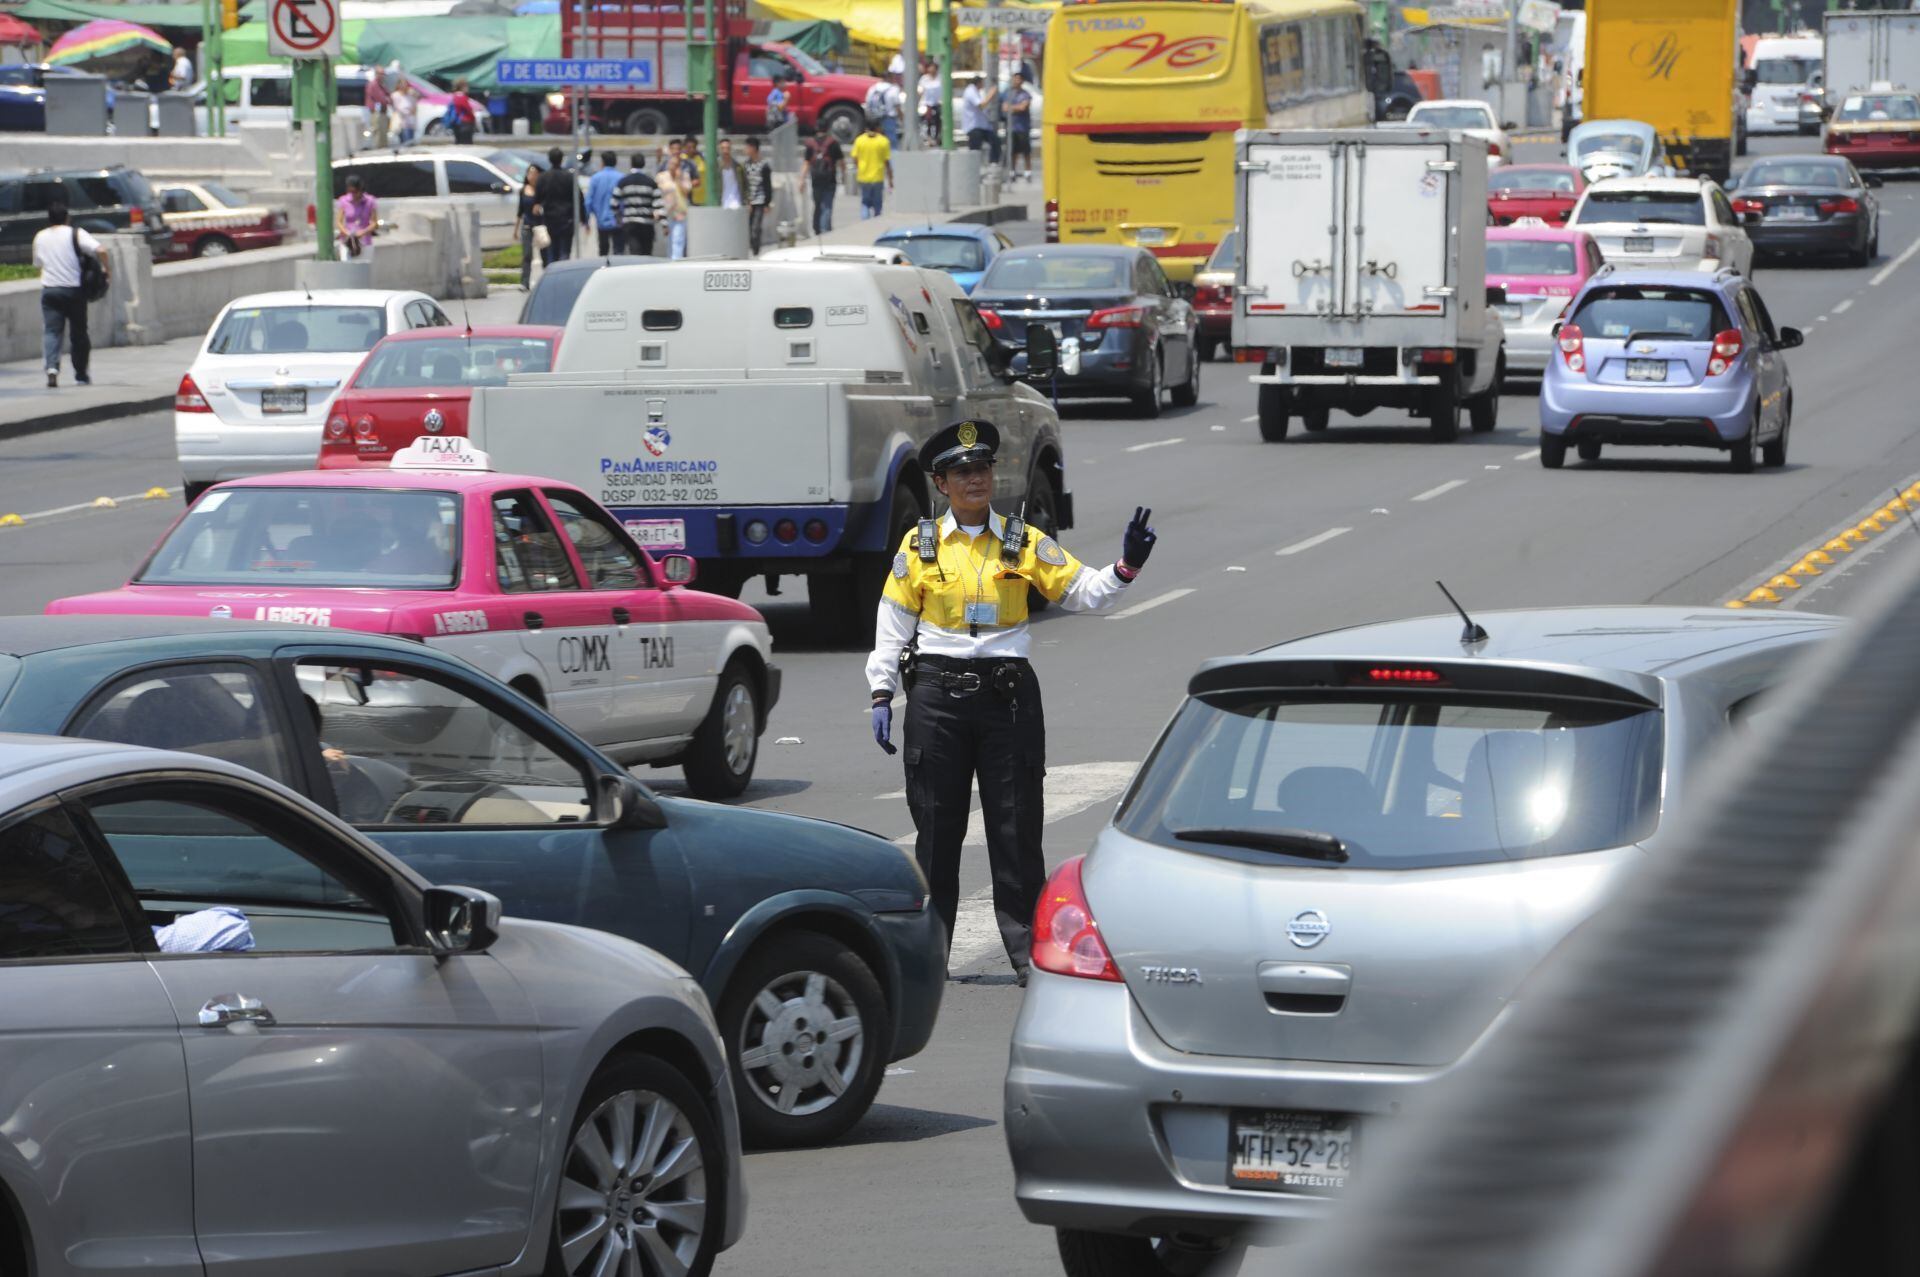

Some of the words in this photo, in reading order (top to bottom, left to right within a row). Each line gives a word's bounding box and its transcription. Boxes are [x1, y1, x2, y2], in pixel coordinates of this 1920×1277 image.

[963, 12, 981, 22] AV
[990, 12, 1048, 24] HIDALG
[502, 63, 511, 80] P
[514, 63, 531, 80] DE
[534, 63, 581, 80] BELLAS
[584, 63, 622, 80] ARTES
[707, 273, 749, 288] 200133
[828, 307, 865, 316] QUEJAS
[421, 437, 461, 453] TAXI
[558, 635, 610, 673] CDMX
[640, 636, 674, 669] TAXI
[1288, 922, 1326, 931] NISSAN
[1141, 966, 1202, 984] TIIDA
